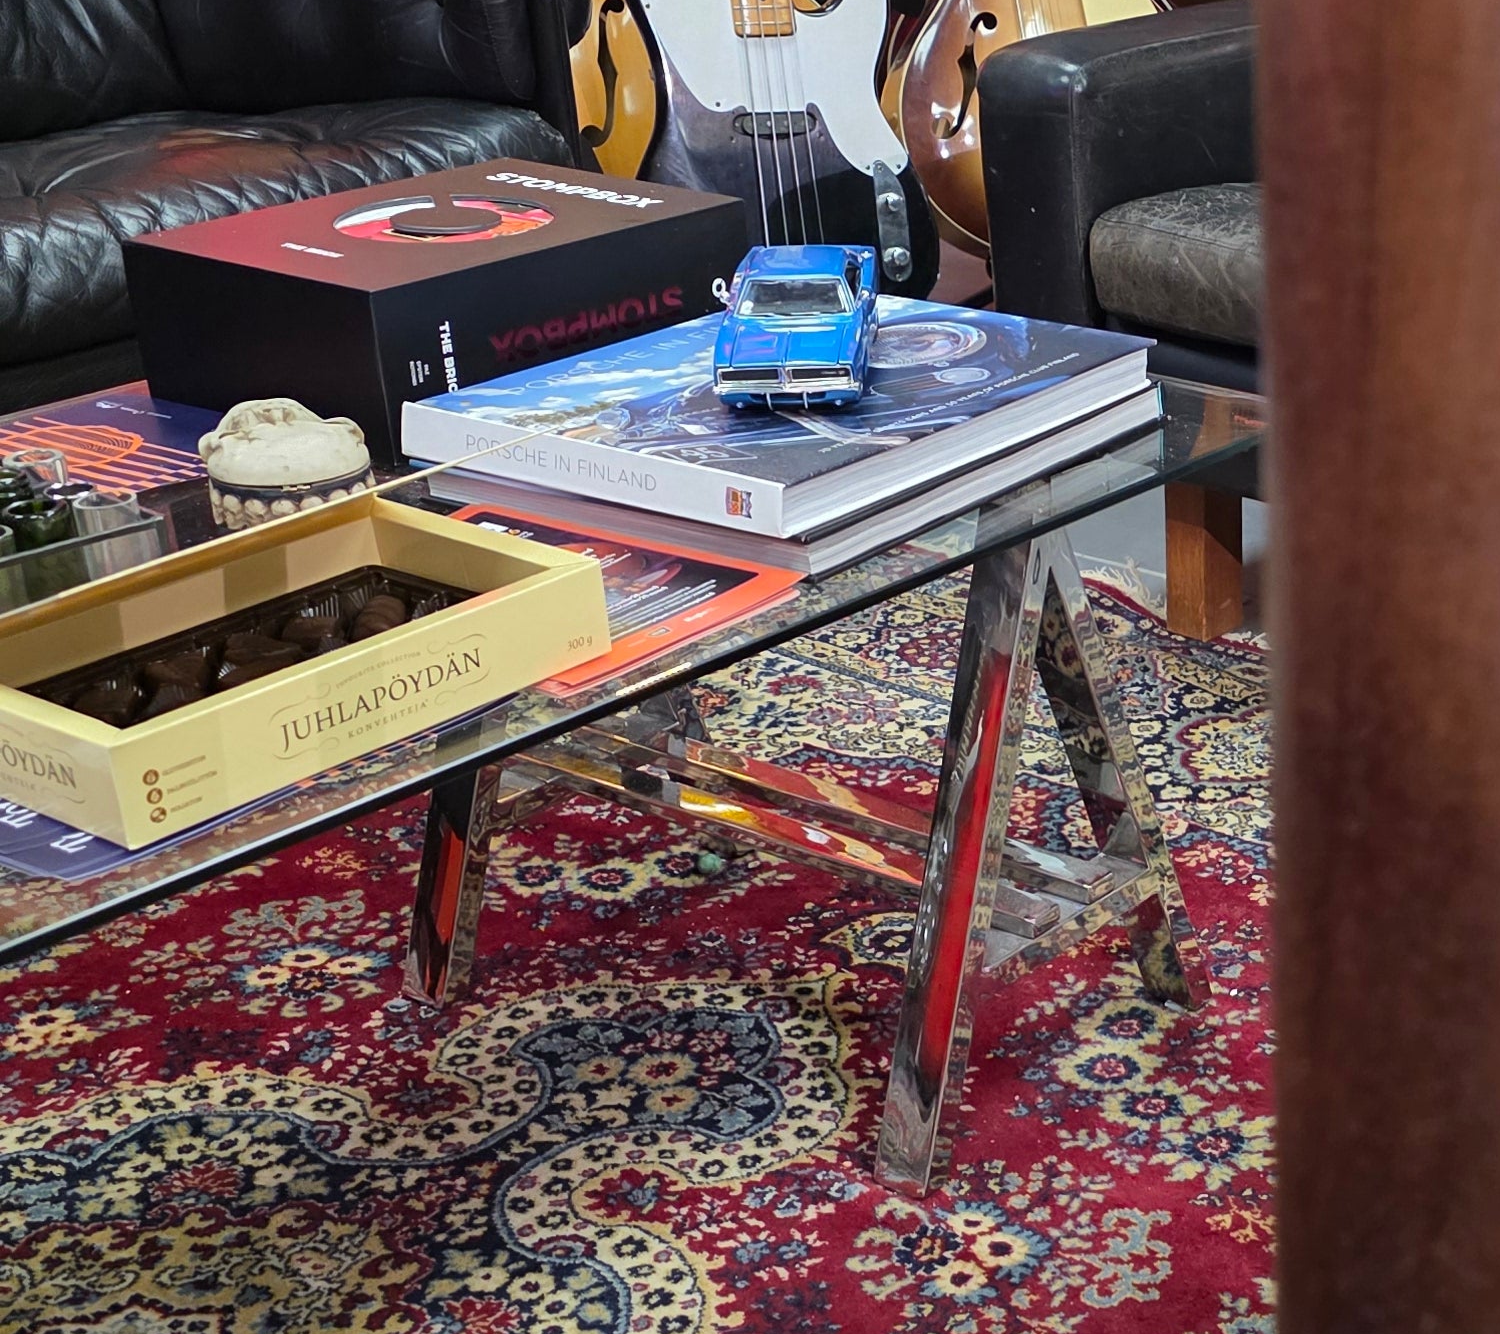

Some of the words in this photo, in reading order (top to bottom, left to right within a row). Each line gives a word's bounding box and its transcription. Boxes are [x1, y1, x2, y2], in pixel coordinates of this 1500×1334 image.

[486, 172, 665, 208] STOMPBOX
[438, 321, 453, 355] THE
[489, 285, 683, 362] STOMPBOX
[465, 433, 548, 468] PORSCHE
[554, 454, 572, 472] IN
[577, 458, 658, 492] FINLAND
[566, 636, 585, 652] 300
[280, 647, 481, 753] JUHLAPÖYDÄN
